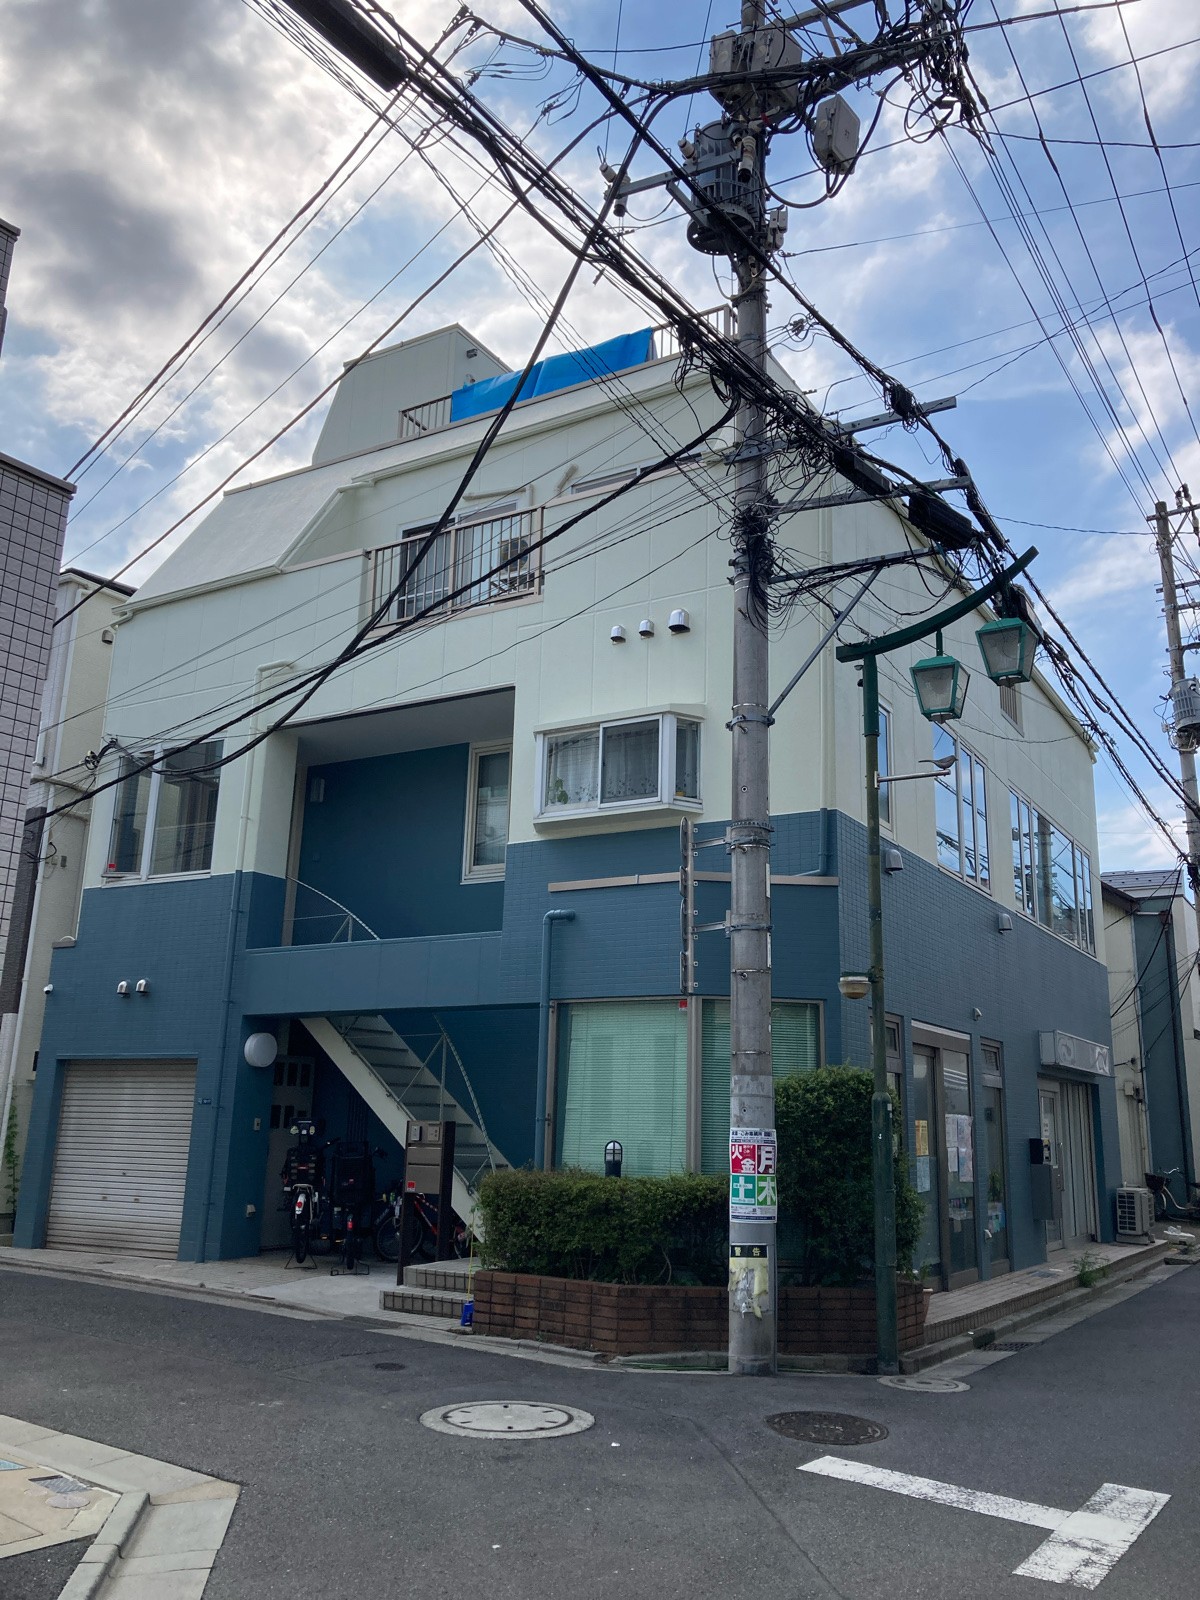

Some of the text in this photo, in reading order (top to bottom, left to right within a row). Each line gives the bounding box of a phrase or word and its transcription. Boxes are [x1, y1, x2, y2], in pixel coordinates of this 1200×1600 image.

[732, 1145, 743, 1159] 火
[758, 1146, 774, 1173] 月
[741, 1158, 755, 1173] 金
[732, 1177, 754, 1203] 土
[757, 1177, 776, 1205] 木
[735, 1247, 761, 1256] 警告
